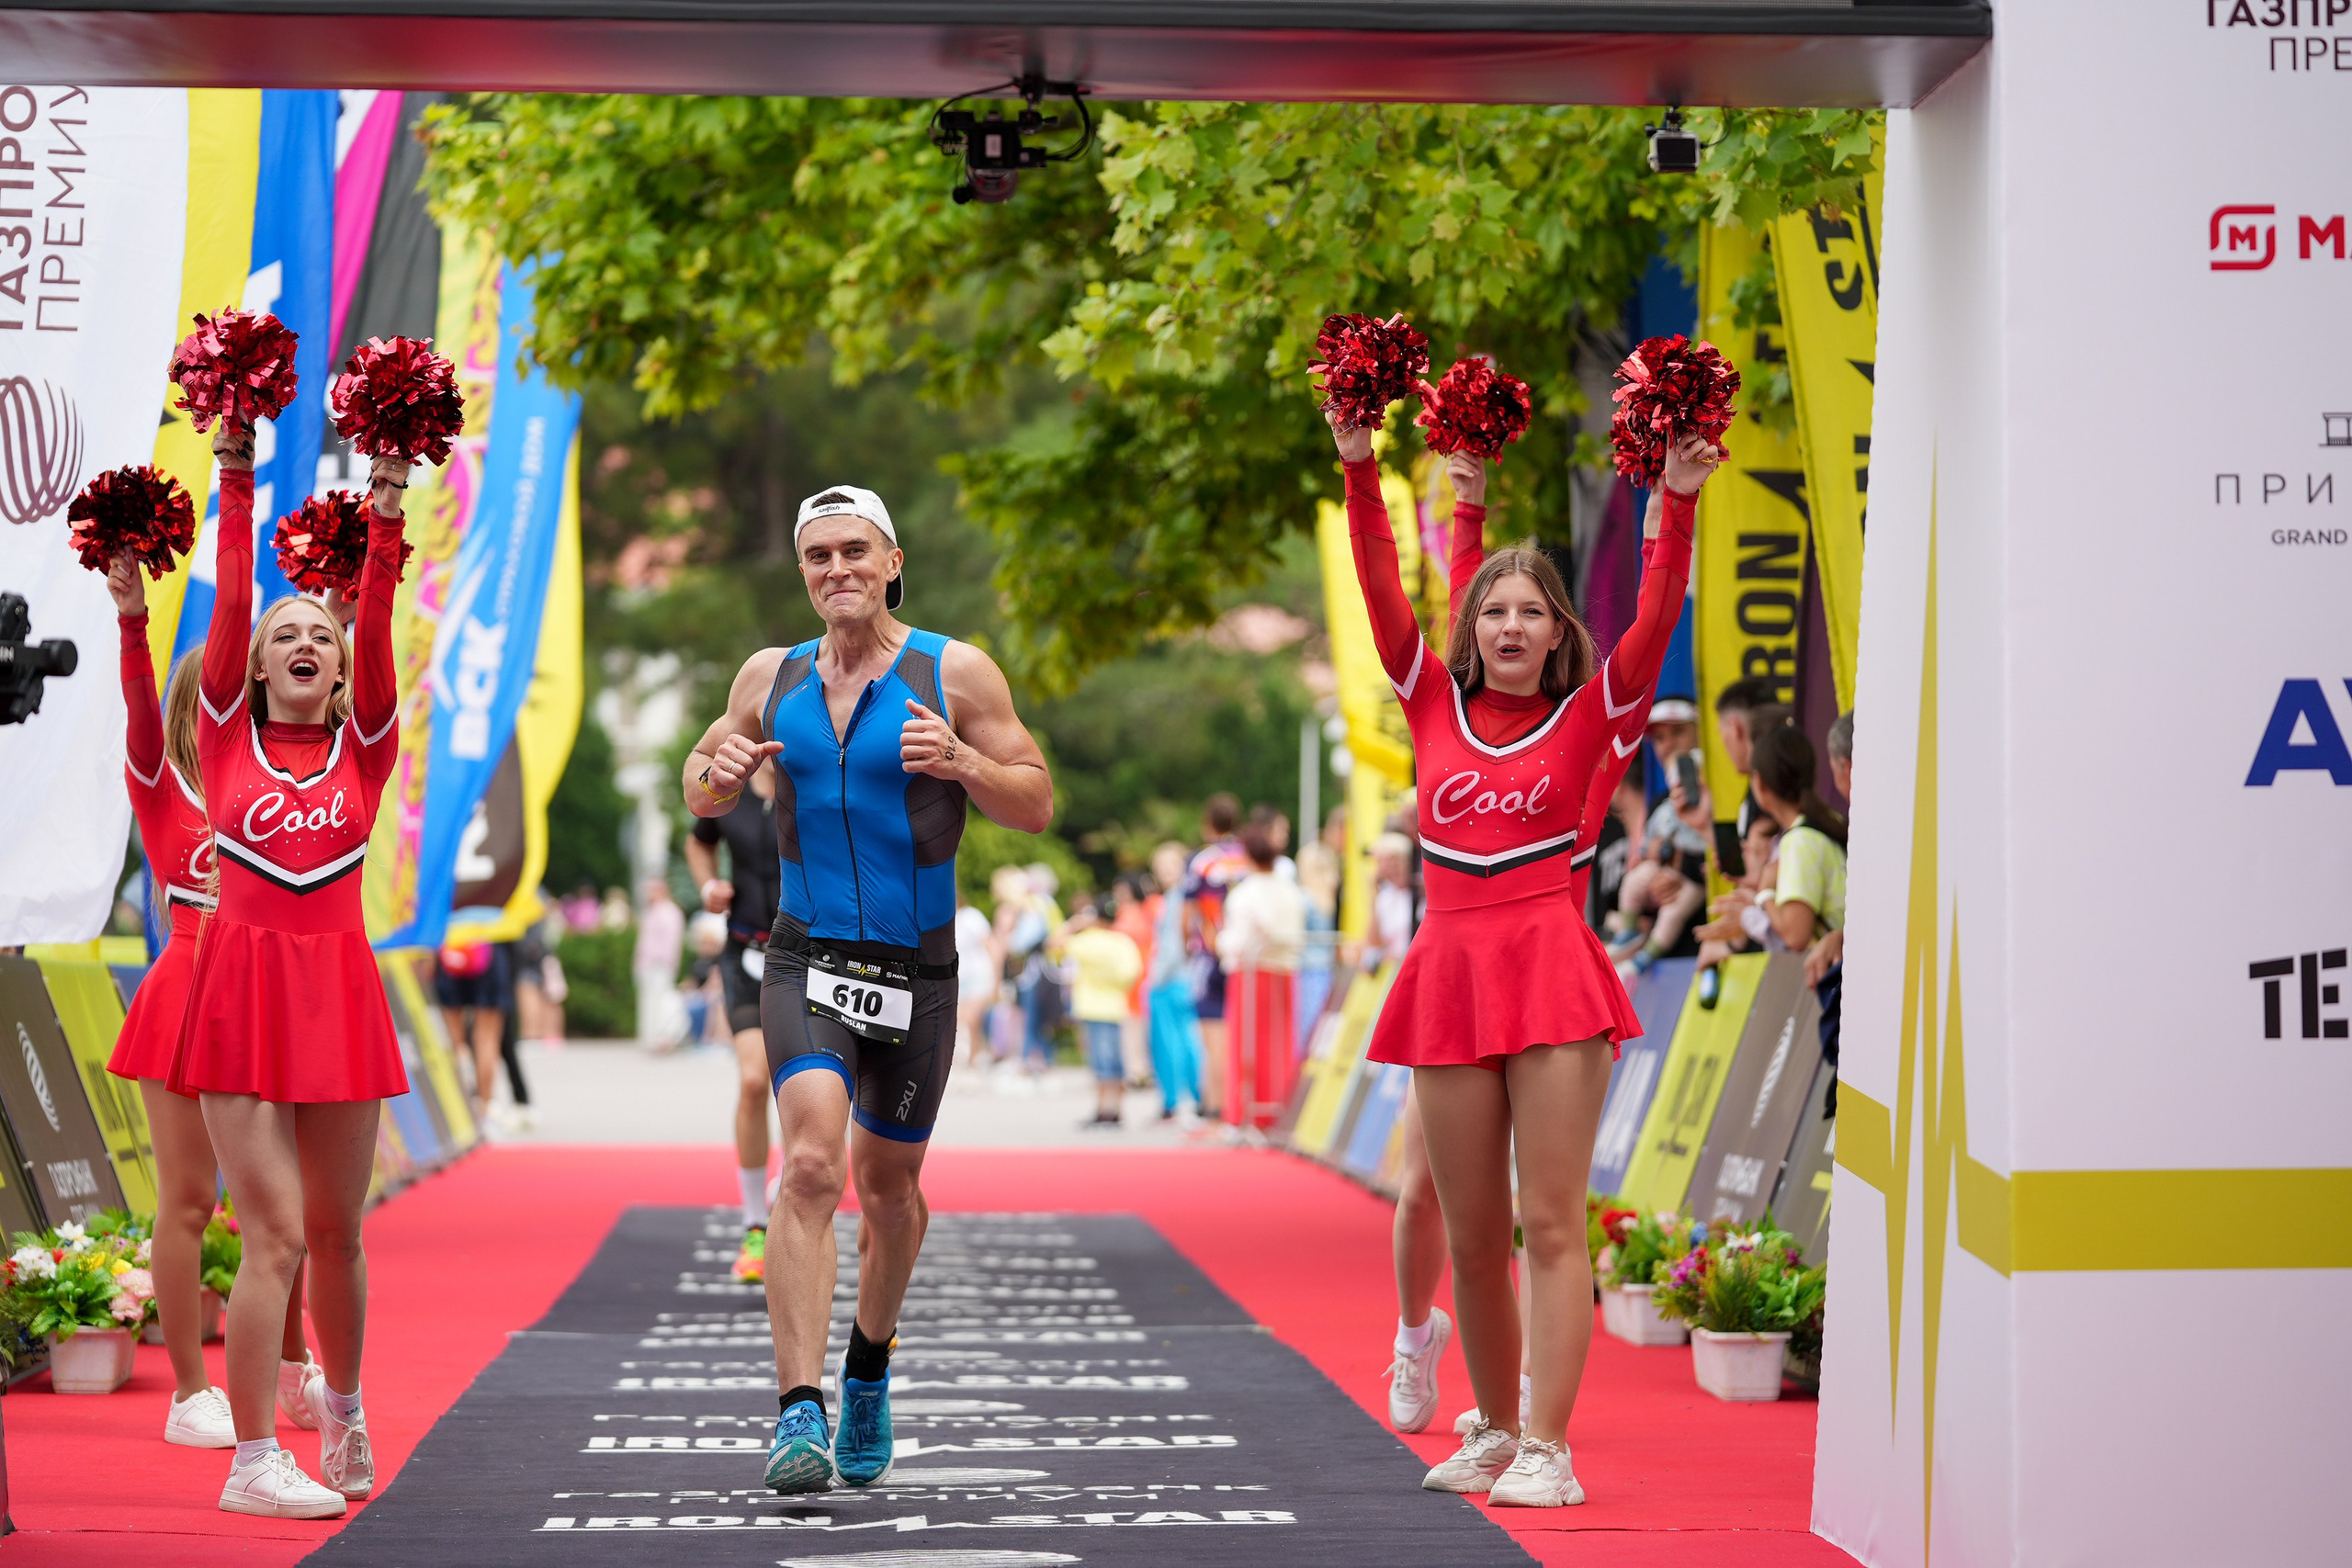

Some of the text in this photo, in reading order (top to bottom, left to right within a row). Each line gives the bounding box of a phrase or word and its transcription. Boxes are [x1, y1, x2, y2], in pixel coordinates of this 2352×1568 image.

[2270, 37, 2352, 71] ПРЕ
[2299, 215, 2352, 259] М
[2215, 473, 2334, 504] ПРИ
[2271, 529, 2348, 546] GRAND
[1736, 532, 1800, 705] RON
[945, 736, 957, 761] 610
[2244, 678, 2352, 787] A
[1431, 770, 1551, 825] Cool
[243, 790, 347, 842] Cool
[847, 960, 862, 970] IRON
[866, 964, 882, 974] STAR
[832, 984, 883, 1017] 610
[841, 1014, 867, 1032] RUSLAN
[896, 1079, 918, 1122] 2XU
[587, 1435, 1239, 1449] IRO STAR
[542, 1510, 1298, 1529] IRON STAR
